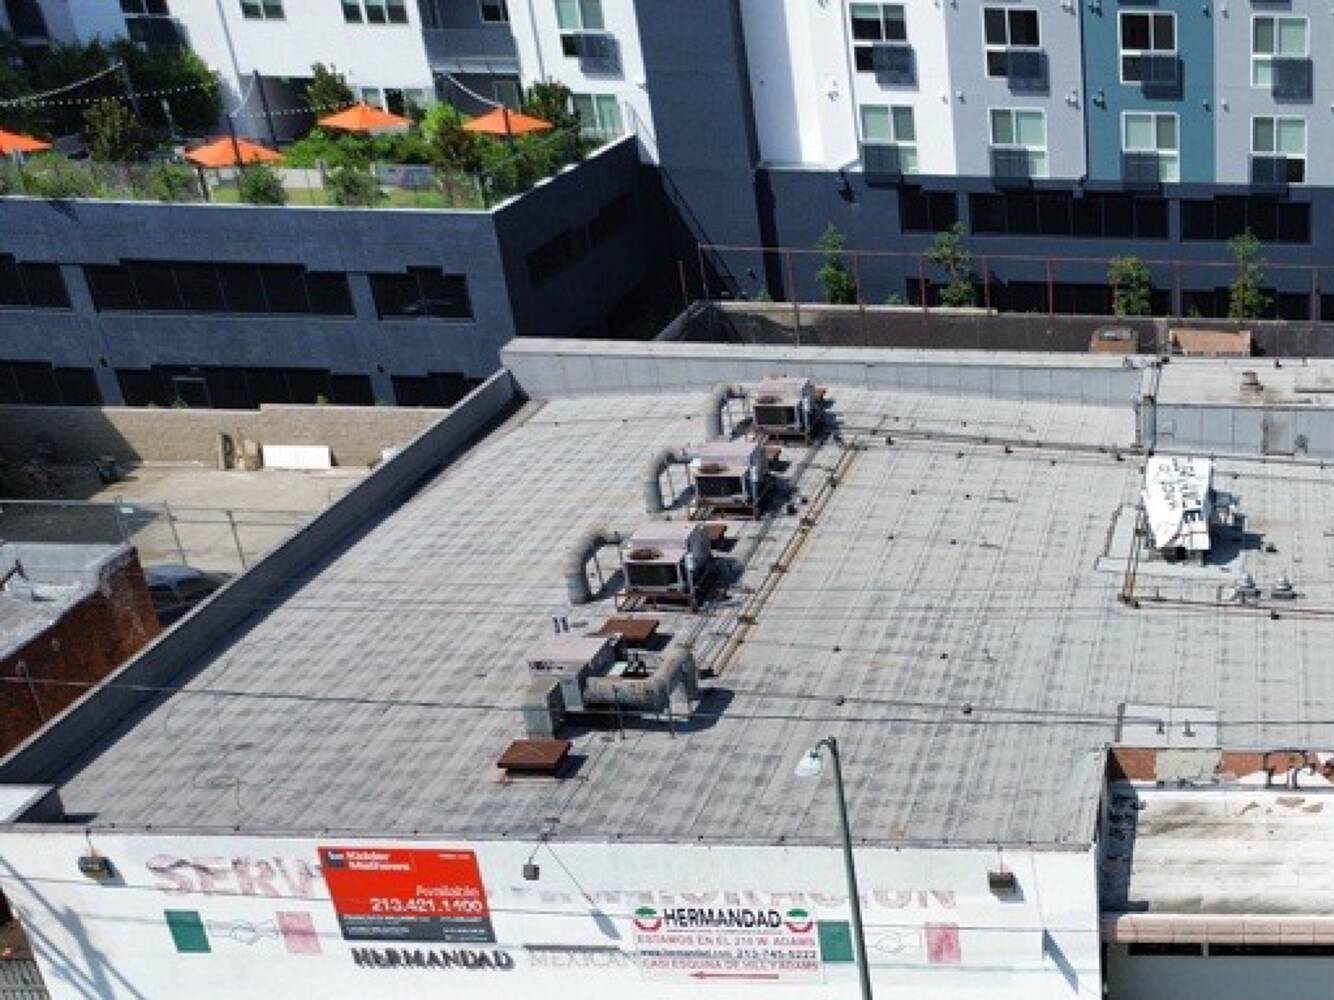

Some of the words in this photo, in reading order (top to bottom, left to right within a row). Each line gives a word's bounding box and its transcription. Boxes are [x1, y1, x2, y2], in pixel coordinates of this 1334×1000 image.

[416, 884, 480, 897] Available
[664, 908, 782, 928] HERMANDAD
[773, 937, 816, 946] ADAMS
[352, 948, 515, 969] HERMANDAD
